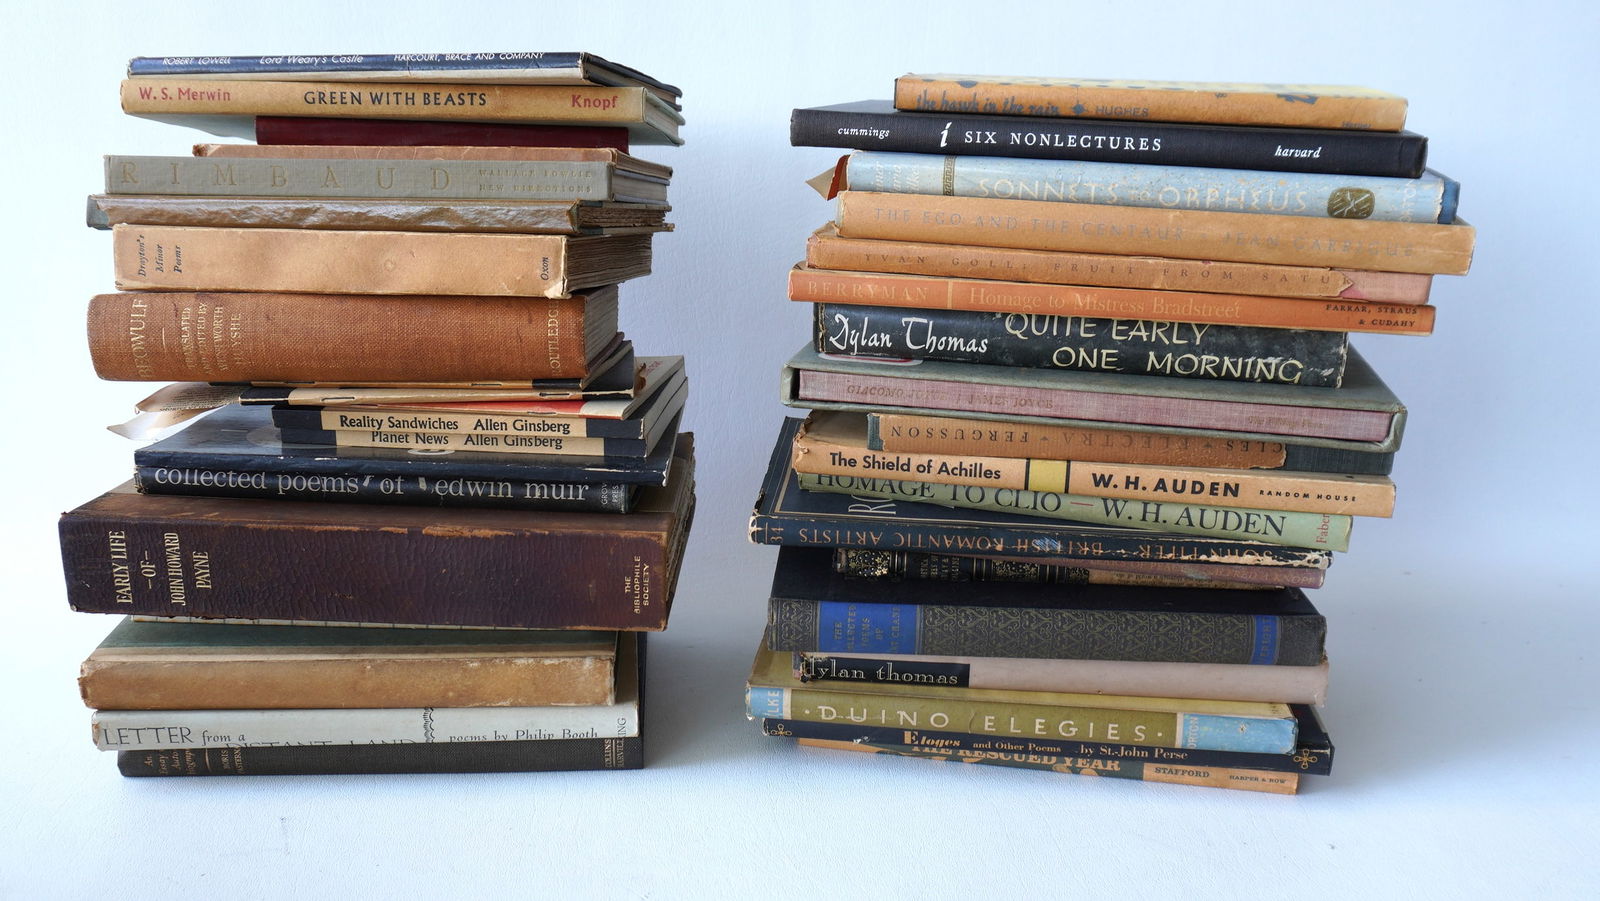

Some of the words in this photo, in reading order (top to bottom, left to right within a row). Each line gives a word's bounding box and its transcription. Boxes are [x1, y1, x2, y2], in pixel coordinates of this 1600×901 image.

[163, 57, 194, 65] ROBERT
[198, 56, 231, 65] LOWELL
[260, 55, 283, 65] Lord
[287, 55, 328, 66] Weary's
[331, 55, 363, 64] Castle
[445, 53, 471, 61] BRACE
[500, 52, 544, 60] COMPANY
[139, 87, 157, 100] W.
[161, 88, 172, 100] S.
[178, 88, 231, 101] Merwin
[304, 91, 362, 105] GREEN
[370, 92, 416, 106] WITH
[423, 92, 487, 106] BEASTS
[571, 94, 618, 110] Knopf
[1096, 105, 1149, 118] HUGHES
[838, 126, 890, 138] cummings
[965, 130, 997, 144] SIX
[1010, 132, 1162, 152] NONLECTURES
[1275, 145, 1322, 159] harvard
[120, 162, 451, 191] RIMBAUD
[977, 178, 1118, 205] SONNETS
[1158, 184, 1308, 214] ORPHEUS
[874, 207, 910, 222] THE
[923, 211, 962, 226] EGO
[975, 215, 1018, 231] AND
[1031, 218, 1069, 234] THE
[1080, 222, 1184, 241] CENTAUR
[136, 235, 150, 277] Drayton's
[155, 244, 164, 273] Minor
[173, 245, 183, 274] Poems
[540, 256, 549, 281] Oxon
[864, 253, 927, 265] YVAN
[1053, 262, 1134, 276] FRUIT
[1162, 268, 1234, 280] FROM
[1262, 274, 1351, 286] SATUR
[808, 280, 929, 301] BERRYMAN
[970, 287, 1042, 311] Homage
[1049, 295, 1066, 310] to
[1073, 292, 1145, 314] Mistress
[1151, 297, 1241, 319] Bradstreet
[1377, 306, 1417, 317] STRAUS
[829, 313, 892, 355] Dylan
[902, 316, 988, 354] Thomas
[1005, 313, 1098, 341] QUITE
[1111, 317, 1211, 347] EARLY
[1371, 319, 1416, 328] CUDAHY
[1052, 346, 1120, 370] ONE
[1146, 351, 1304, 384] MORNING
[340, 414, 383, 431] Reality
[388, 416, 459, 431] Sandwiches
[474, 418, 510, 432] Allen
[513, 419, 571, 436] Ginsberg
[890, 426, 1029, 443] FERGUSSON
[372, 431, 410, 445] Planet
[415, 432, 449, 446] News
[464, 434, 500, 447] Allen
[504, 435, 563, 450] Ginsberg
[830, 452, 858, 469] The
[862, 454, 911, 473] Shield
[916, 458, 933, 475] of
[938, 460, 1001, 480] Achilles
[154, 467, 267, 490] collected
[277, 473, 359, 495] poems
[434, 477, 513, 499] edwin
[524, 483, 590, 502] muir
[600, 483, 608, 505] GROV
[612, 484, 620, 504] PRES
[816, 474, 936, 498] HOMAGE
[944, 482, 986, 505] TO
[994, 488, 1062, 513] CLIO
[1092, 472, 1118, 489] W.
[1125, 476, 1148, 491] H.
[1154, 478, 1240, 498] AUDEN
[1259, 490, 1310, 499] RANDOM
[1317, 494, 1357, 502] HOUSE
[1100, 498, 1133, 520] W.
[1142, 501, 1168, 524] H.
[1174, 506, 1287, 538] AUDEN
[108, 530, 127, 560] LIFE
[798, 526, 883, 545] ARTISTS
[895, 531, 1005, 553] ROMANTIC
[164, 532, 184, 577] HOWARD
[112, 560, 133, 604] EARLY
[192, 550, 213, 590] PAYNE
[170, 577, 186, 606] JOHN
[624, 576, 632, 594] THE
[633, 555, 642, 614] BIBLIOPHILE
[642, 562, 650, 606] SOCIETY
[800, 654, 866, 680] dylan
[876, 662, 959, 686] thomas
[450, 732, 487, 742] poems
[494, 730, 508, 742] by
[516, 728, 555, 740] Philip
[562, 727, 598, 739] Booth
[818, 705, 950, 728] DUINO
[984, 716, 1146, 742] ELEGIES
[1188, 717, 1198, 749] ORTON
[104, 726, 195, 746] LETTER
[202, 730, 232, 747] from
[238, 734, 246, 742] a
[904, 730, 961, 748] Eloges
[973, 741, 992, 750] and
[995, 742, 1025, 752] Other
[1028, 743, 1062, 753] Poems
[1080, 744, 1094, 756] by
[1100, 745, 1149, 758] St.-John
[1154, 748, 1188, 760] Perse
[957, 748, 1057, 766] RESCUED
[1064, 757, 1121, 771] YEAR
[1154, 767, 1210, 778] STAFFORD
[1230, 774, 1260, 782] HARPER
